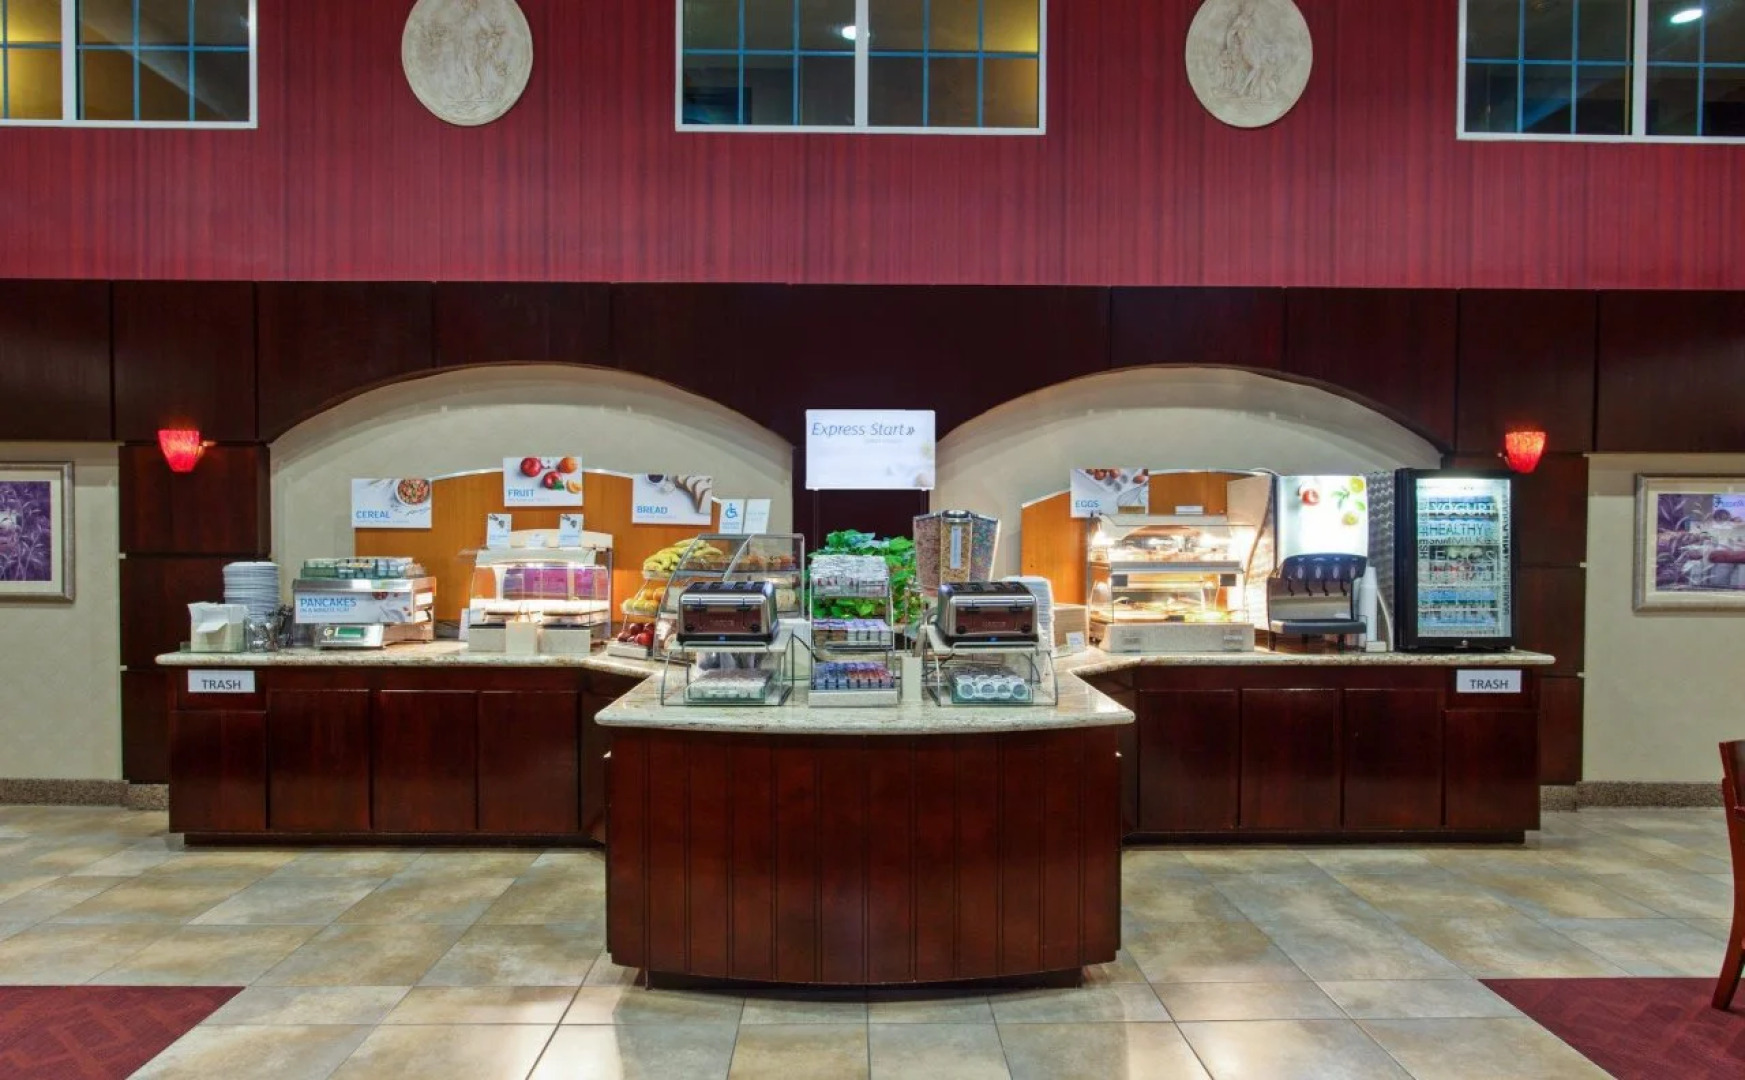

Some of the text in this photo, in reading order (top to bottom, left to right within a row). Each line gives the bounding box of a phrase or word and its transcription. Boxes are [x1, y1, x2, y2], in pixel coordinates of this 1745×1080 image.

[811, 422, 905, 437] Express Start
[507, 489, 534, 497] FRUIT
[1075, 500, 1100, 508] EGGS
[636, 505, 668, 514] BREAD
[356, 510, 391, 519] CEREAL
[1429, 523, 1484, 535] HEALTHY
[300, 598, 357, 607] PANCAKES
[201, 679, 241, 690] TRASH
[1469, 679, 1509, 690] TRASH
